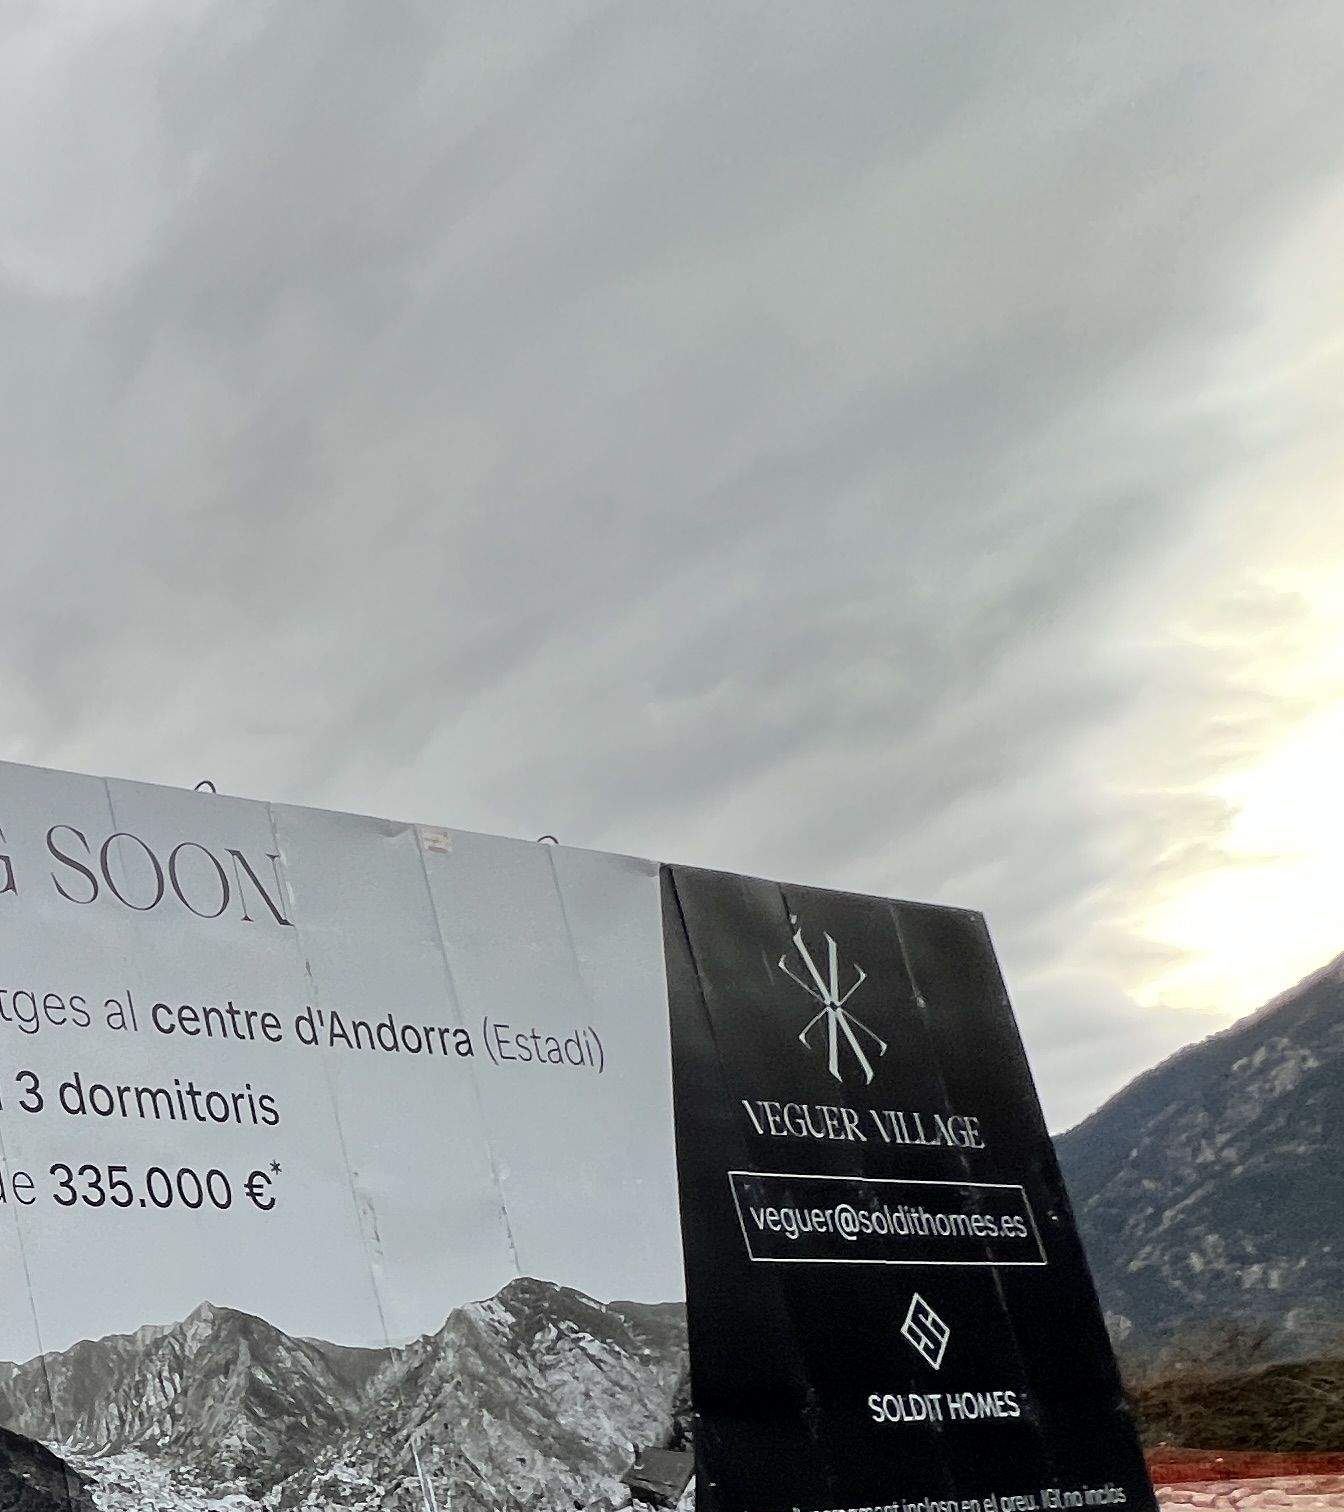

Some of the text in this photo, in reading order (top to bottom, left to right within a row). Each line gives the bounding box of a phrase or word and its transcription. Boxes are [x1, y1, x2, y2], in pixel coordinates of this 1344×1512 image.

[45, 824, 295, 928] SOON
[103, 989, 139, 1032] al
[150, 1000, 283, 1043] centre
[294, 1005, 475, 1058] d'Andorra
[482, 1015, 605, 1074] (Estadi)
[14, 1070, 45, 1114] 3
[58, 1071, 281, 1127] dormitoris
[741, 1098, 986, 1149] VEGUER VILLAGE
[48, 1162, 233, 1210] 335.000
[749, 1203, 1029, 1241] veguer@soldithomes.es
[867, 1390, 1022, 1423] SOLDIT HOMES
